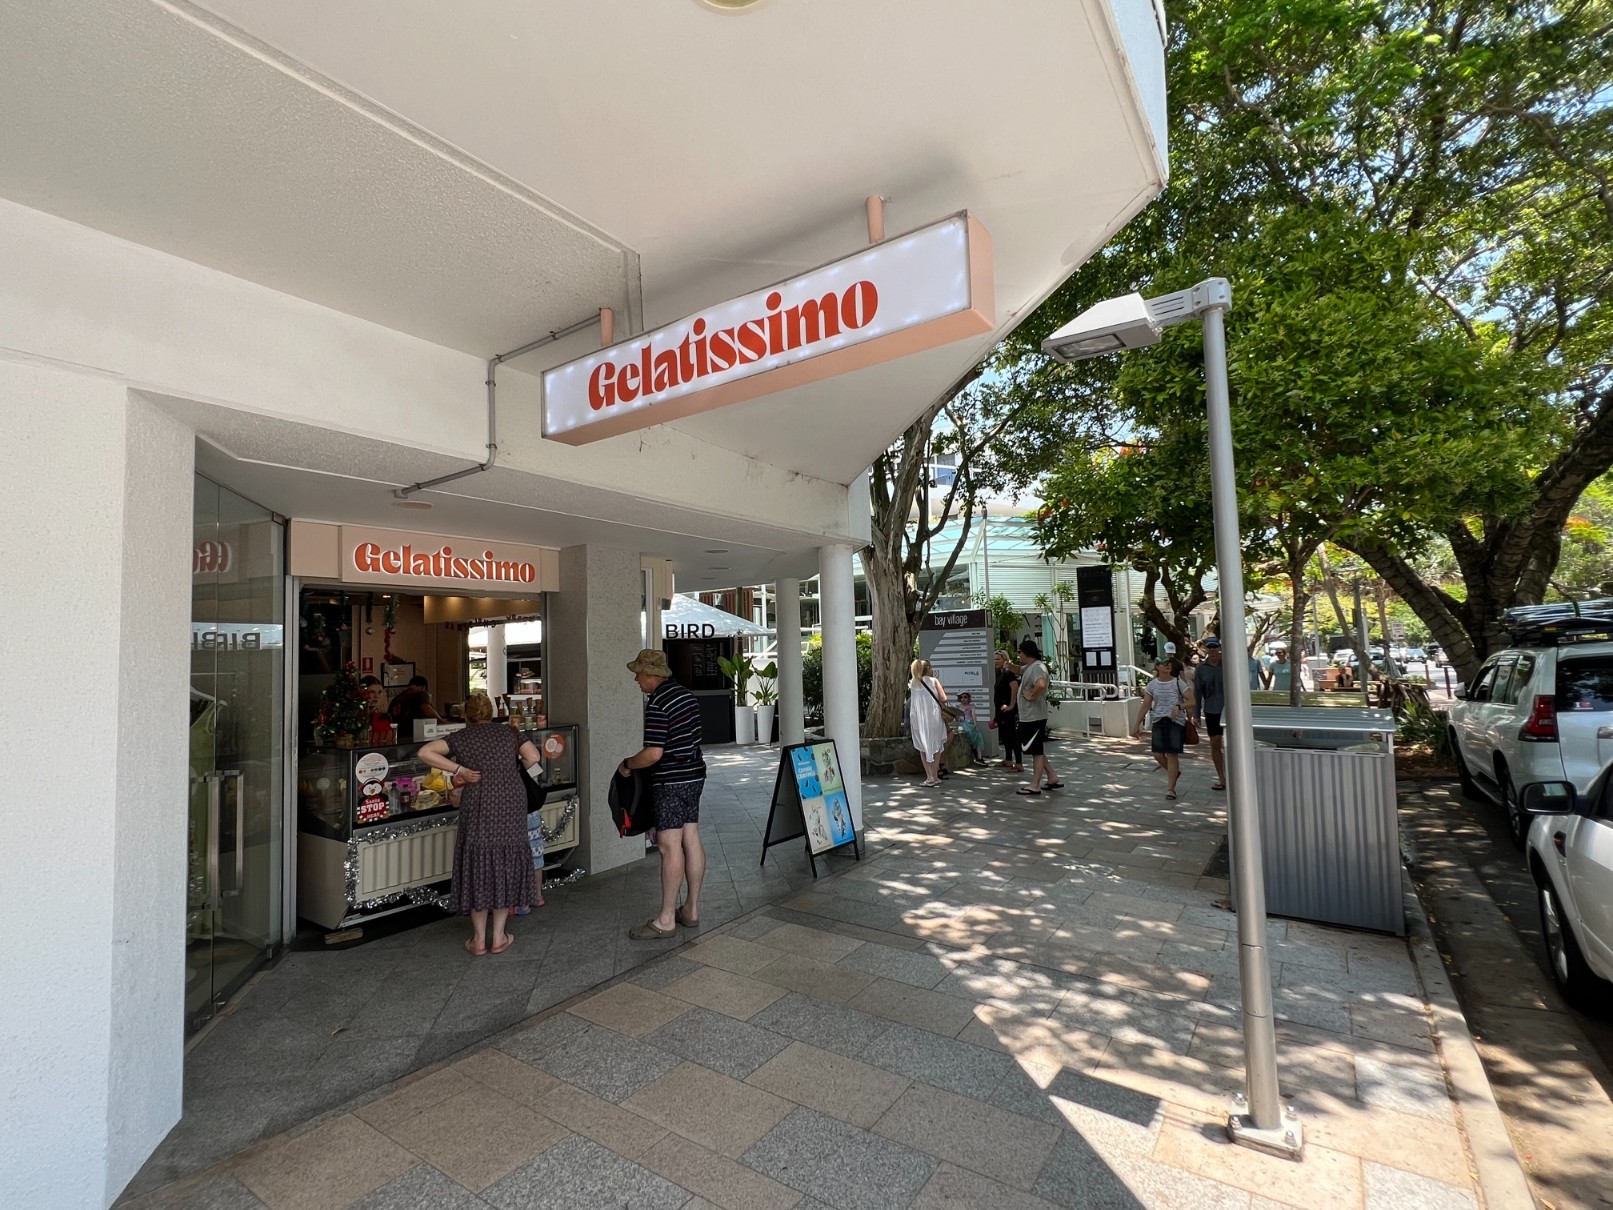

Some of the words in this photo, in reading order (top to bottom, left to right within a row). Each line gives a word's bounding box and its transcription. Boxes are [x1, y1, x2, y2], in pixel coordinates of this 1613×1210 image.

[588, 280, 879, 411] Gelatissimo
[354, 542, 537, 583] Gelatissimo
[934, 615, 946, 628] bay
[947, 614, 968, 627] village
[665, 623, 715, 639] BIRD
[360, 801, 385, 814] STOP
